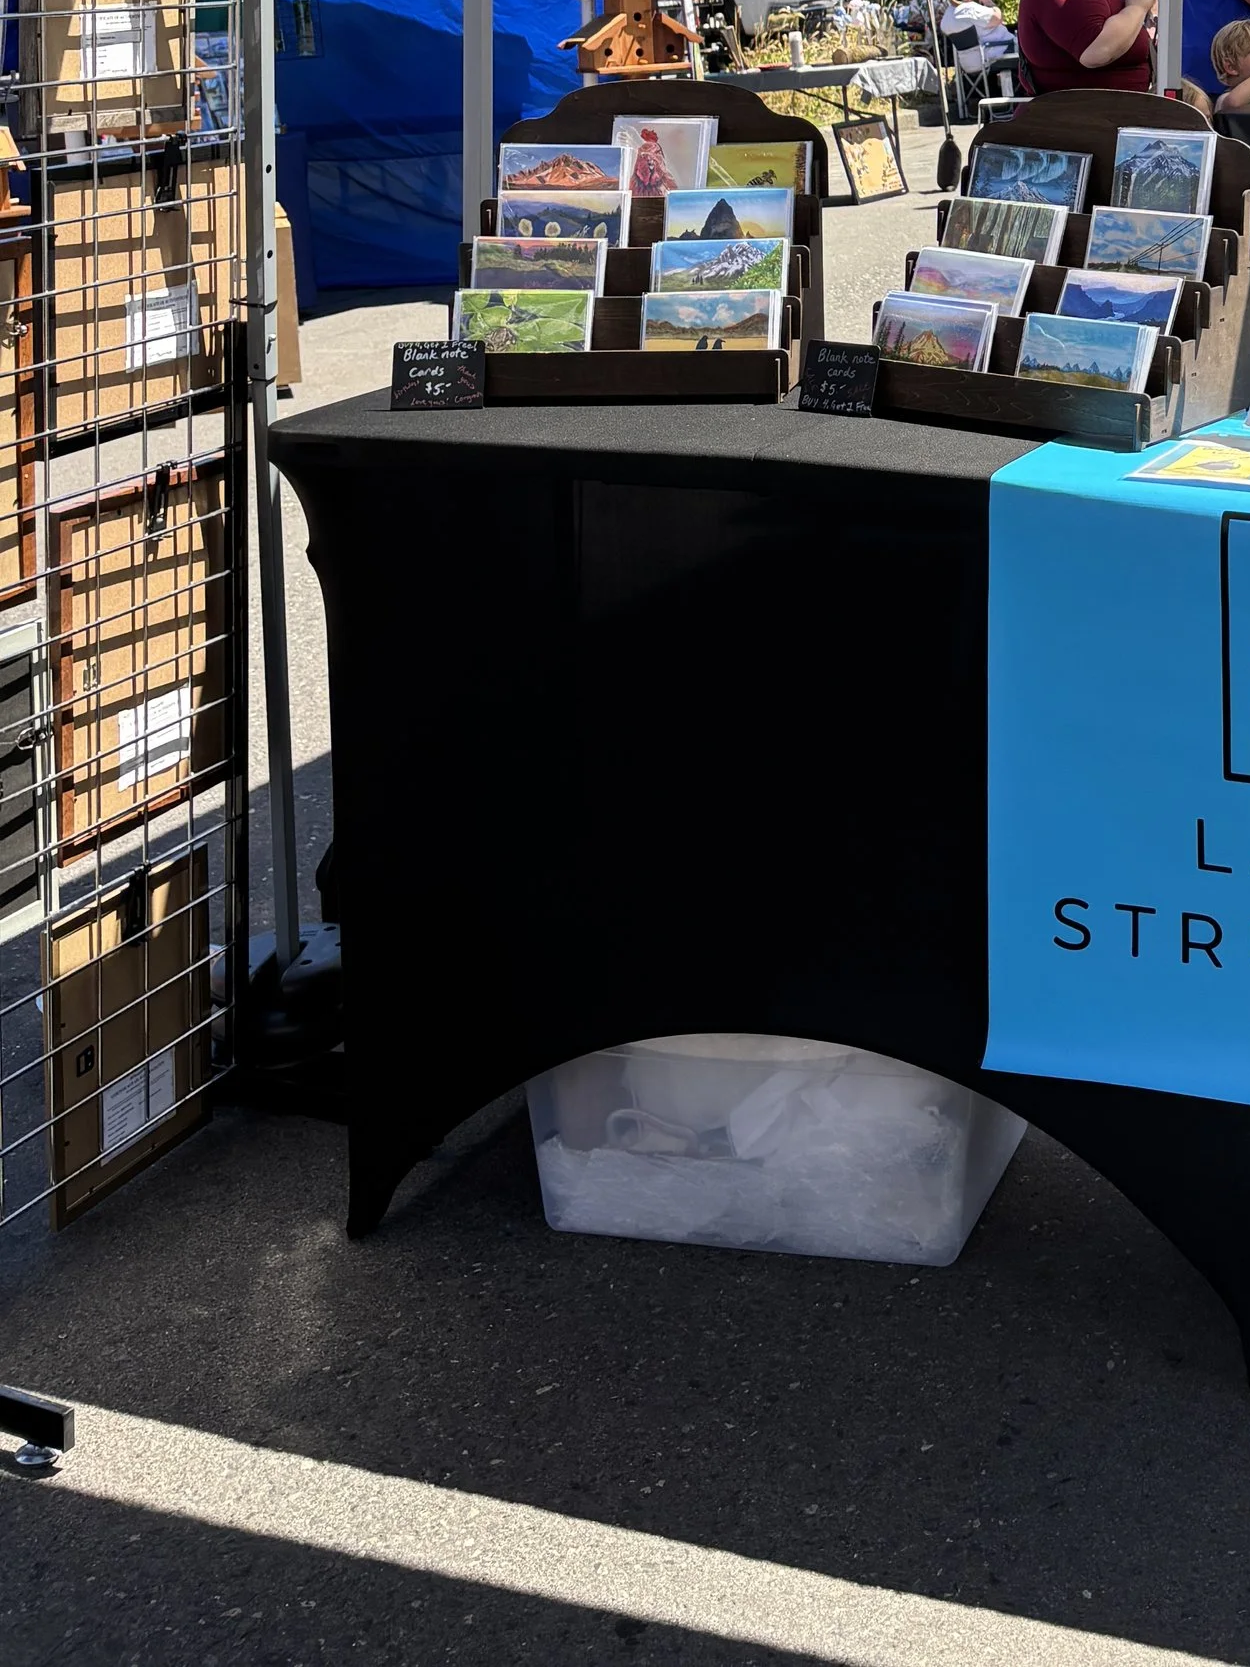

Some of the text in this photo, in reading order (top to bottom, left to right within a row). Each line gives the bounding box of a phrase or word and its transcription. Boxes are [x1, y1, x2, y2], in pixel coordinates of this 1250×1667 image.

[451, 341, 477, 351] Free!
[403, 349, 469, 361] Blank note
[817, 348, 876, 364] Blank note
